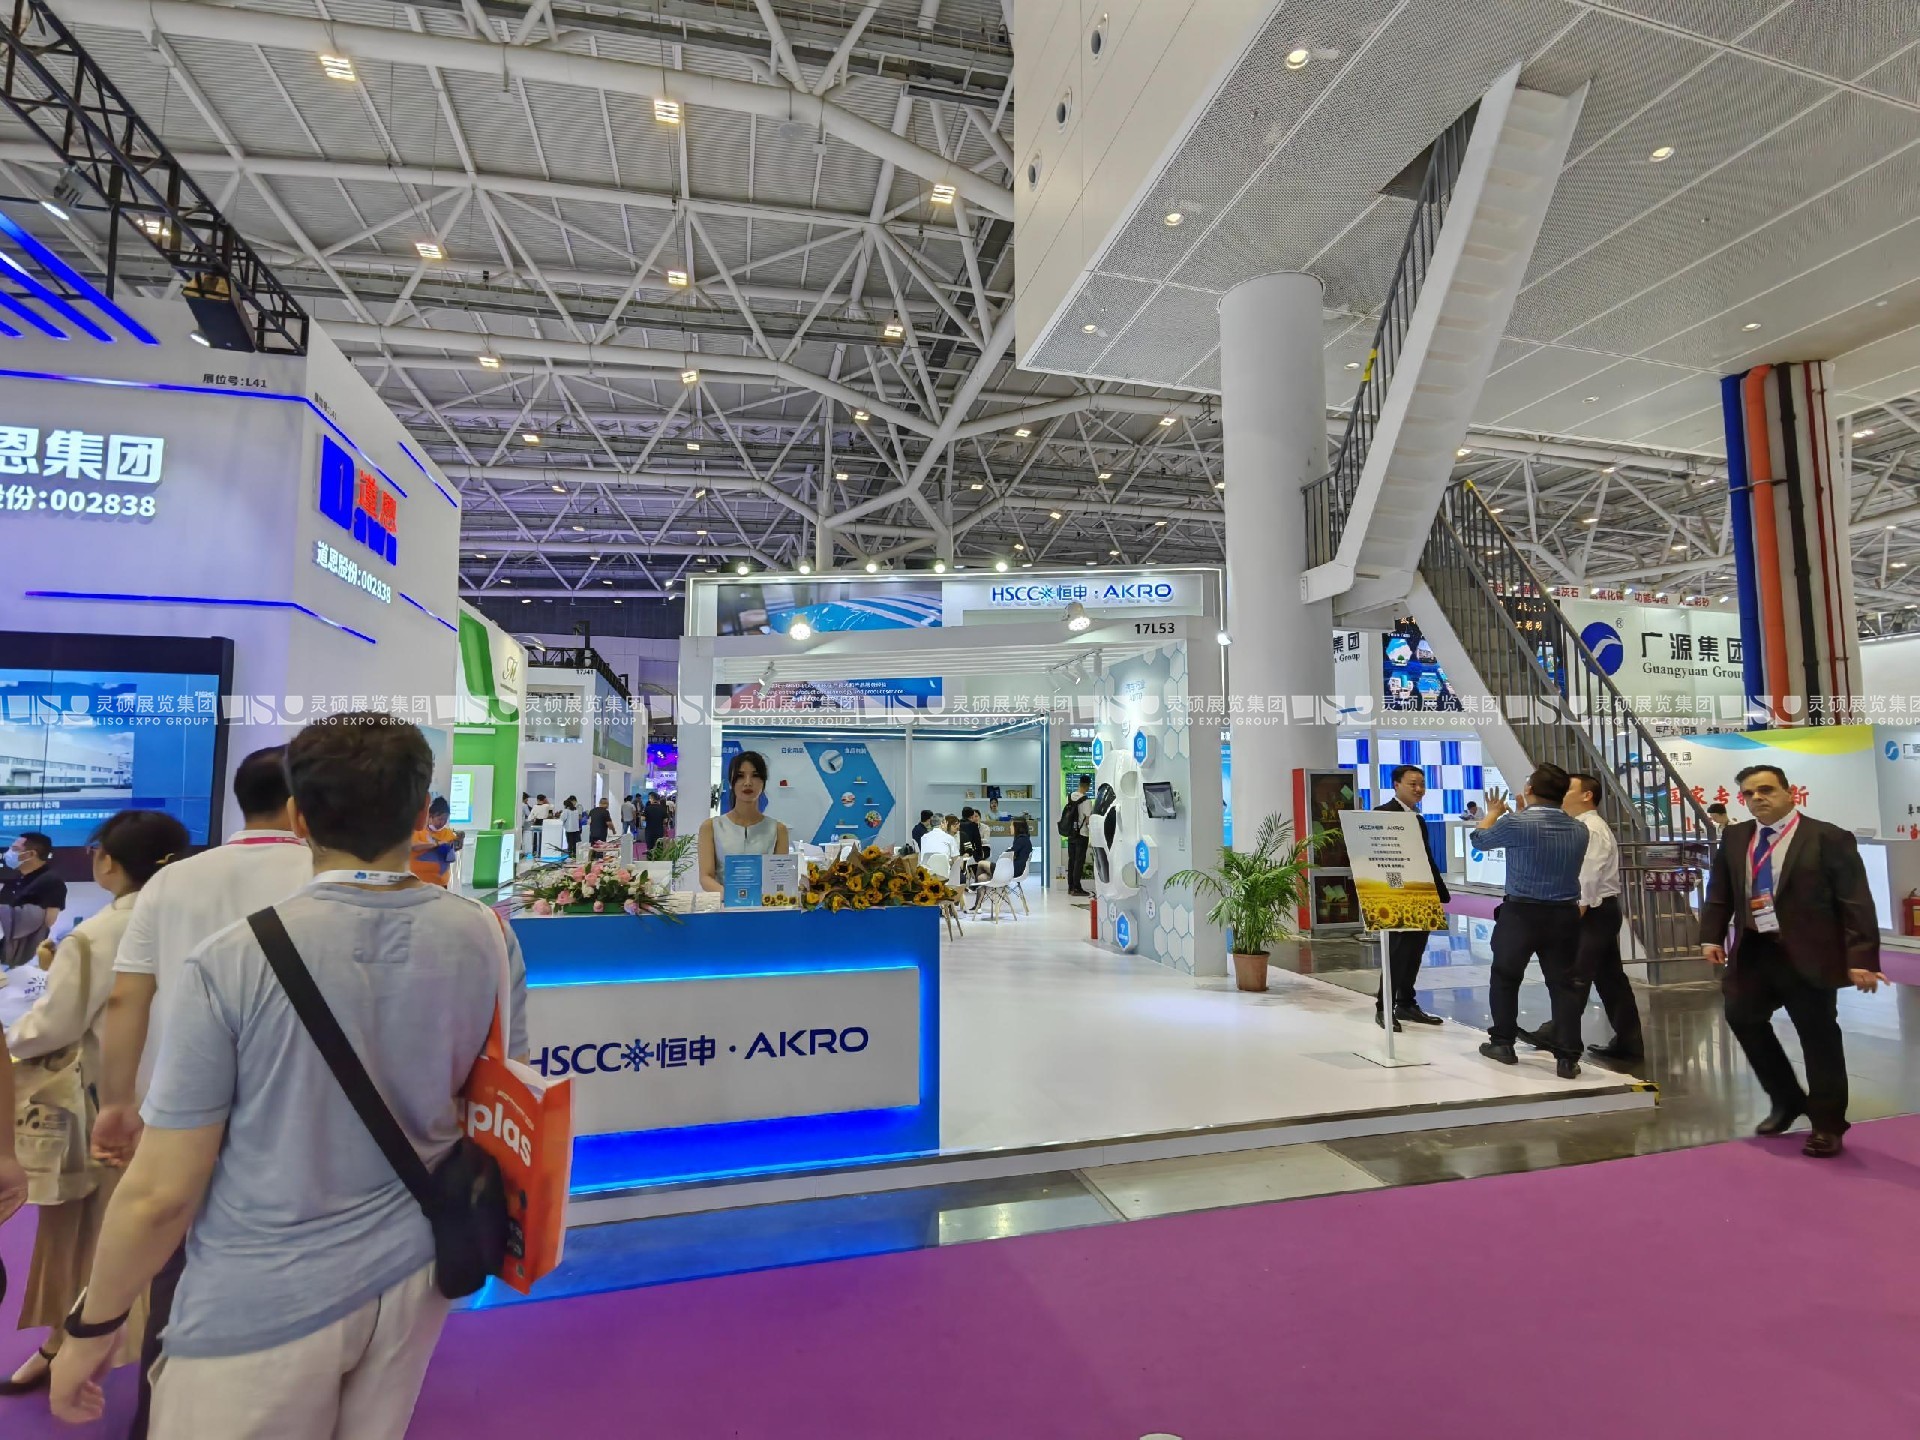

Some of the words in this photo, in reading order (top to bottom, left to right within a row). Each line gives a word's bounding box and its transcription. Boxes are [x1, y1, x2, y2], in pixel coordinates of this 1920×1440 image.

[203, 373, 267, 388] 展位号:L41
[0, 426, 164, 483] 恩集团
[0, 485, 155, 516] 份:002838
[317, 540, 391, 604] 道恩股份:002838
[992, 586, 1040, 601] HSCC
[1056, 585, 1087, 600] 恒申
[1103, 583, 1172, 599] AKRO
[1134, 622, 1175, 635] 17L53
[1641, 632, 1743, 664] 广源集团
[1642, 662, 1708, 678] Guangyuan
[656, 1034, 716, 1069] 恒申
[745, 1026, 869, 1060] AKRO
